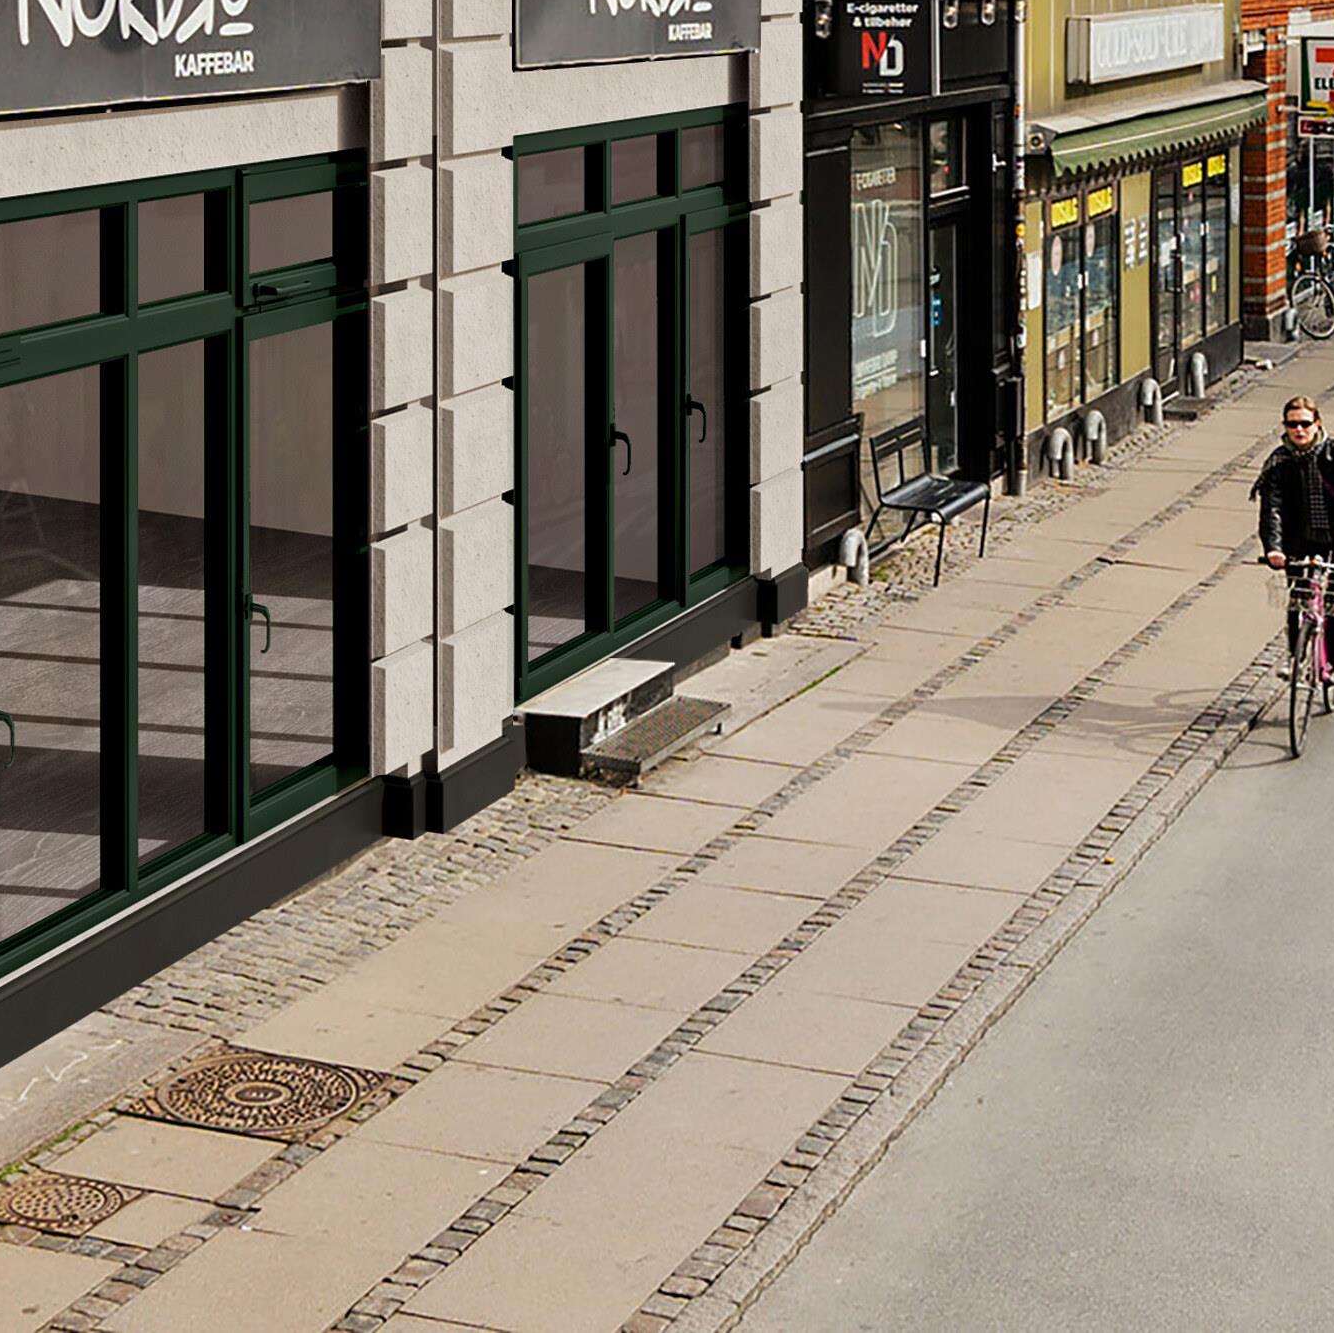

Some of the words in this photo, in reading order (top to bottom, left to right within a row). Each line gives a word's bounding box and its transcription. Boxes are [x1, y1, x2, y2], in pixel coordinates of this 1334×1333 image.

[846, 3, 919, 15] E-cigaretter
[668, 22, 713, 42] KAFFEBAR
[175, 51, 254, 77] KAFFEBAR
